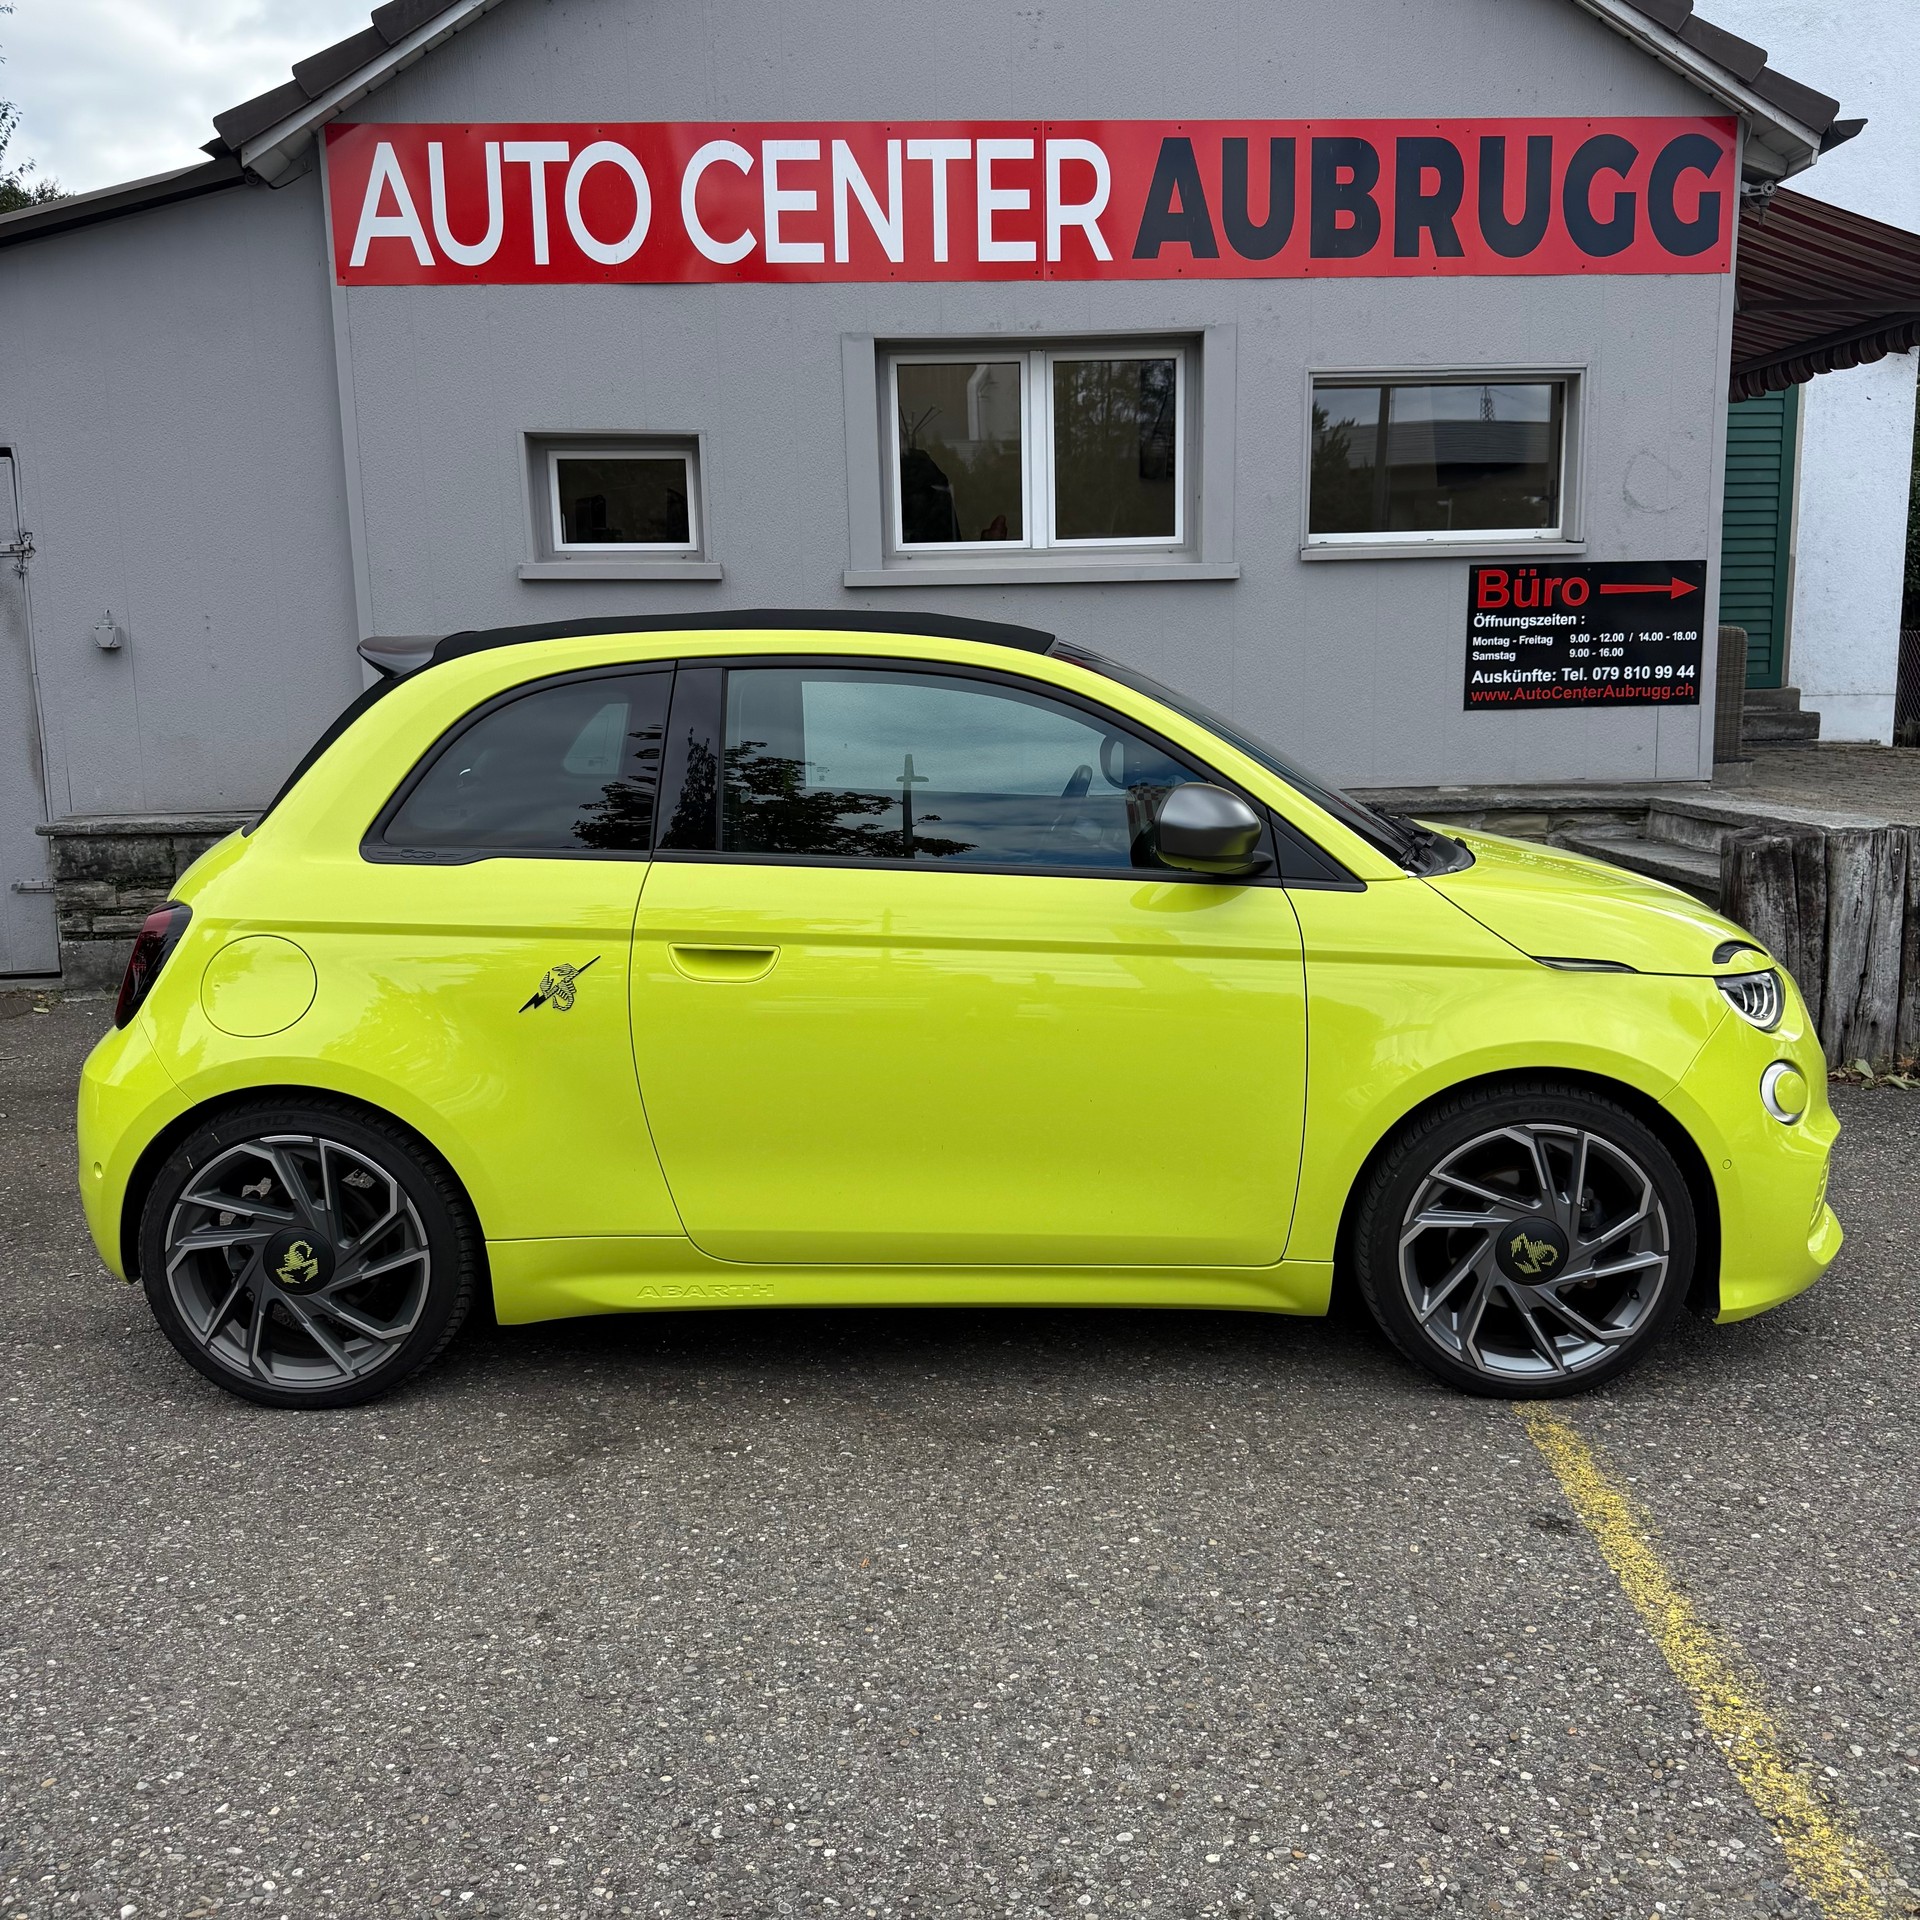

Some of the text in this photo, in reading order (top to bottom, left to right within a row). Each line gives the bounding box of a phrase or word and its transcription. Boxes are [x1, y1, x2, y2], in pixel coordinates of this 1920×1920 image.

[349, 133, 1724, 267] AUTO CENTER AUBRUGG
[1478, 569, 1589, 608] Büro
[1474, 614, 1577, 629] Öffnungszeiten
[1473, 636, 1509, 647] Montag
[1519, 635, 1553, 646] Freitag
[1570, 634, 1590, 643] 9.00
[1599, 633, 1624, 642] 12.00
[1639, 632, 1663, 642] 14.00
[1673, 632, 1697, 641] 18.00
[1472, 651, 1516, 662] Samstag
[1570, 649, 1590, 658] 9.00
[1599, 648, 1624, 657] 16.00
[1471, 665, 1695, 684] Auskünfte: Tel. 079 810 99 44
[1471, 683, 1694, 701] www.AutoCenterAubrugg.ch
[637, 1284, 775, 1298] ABARTH
